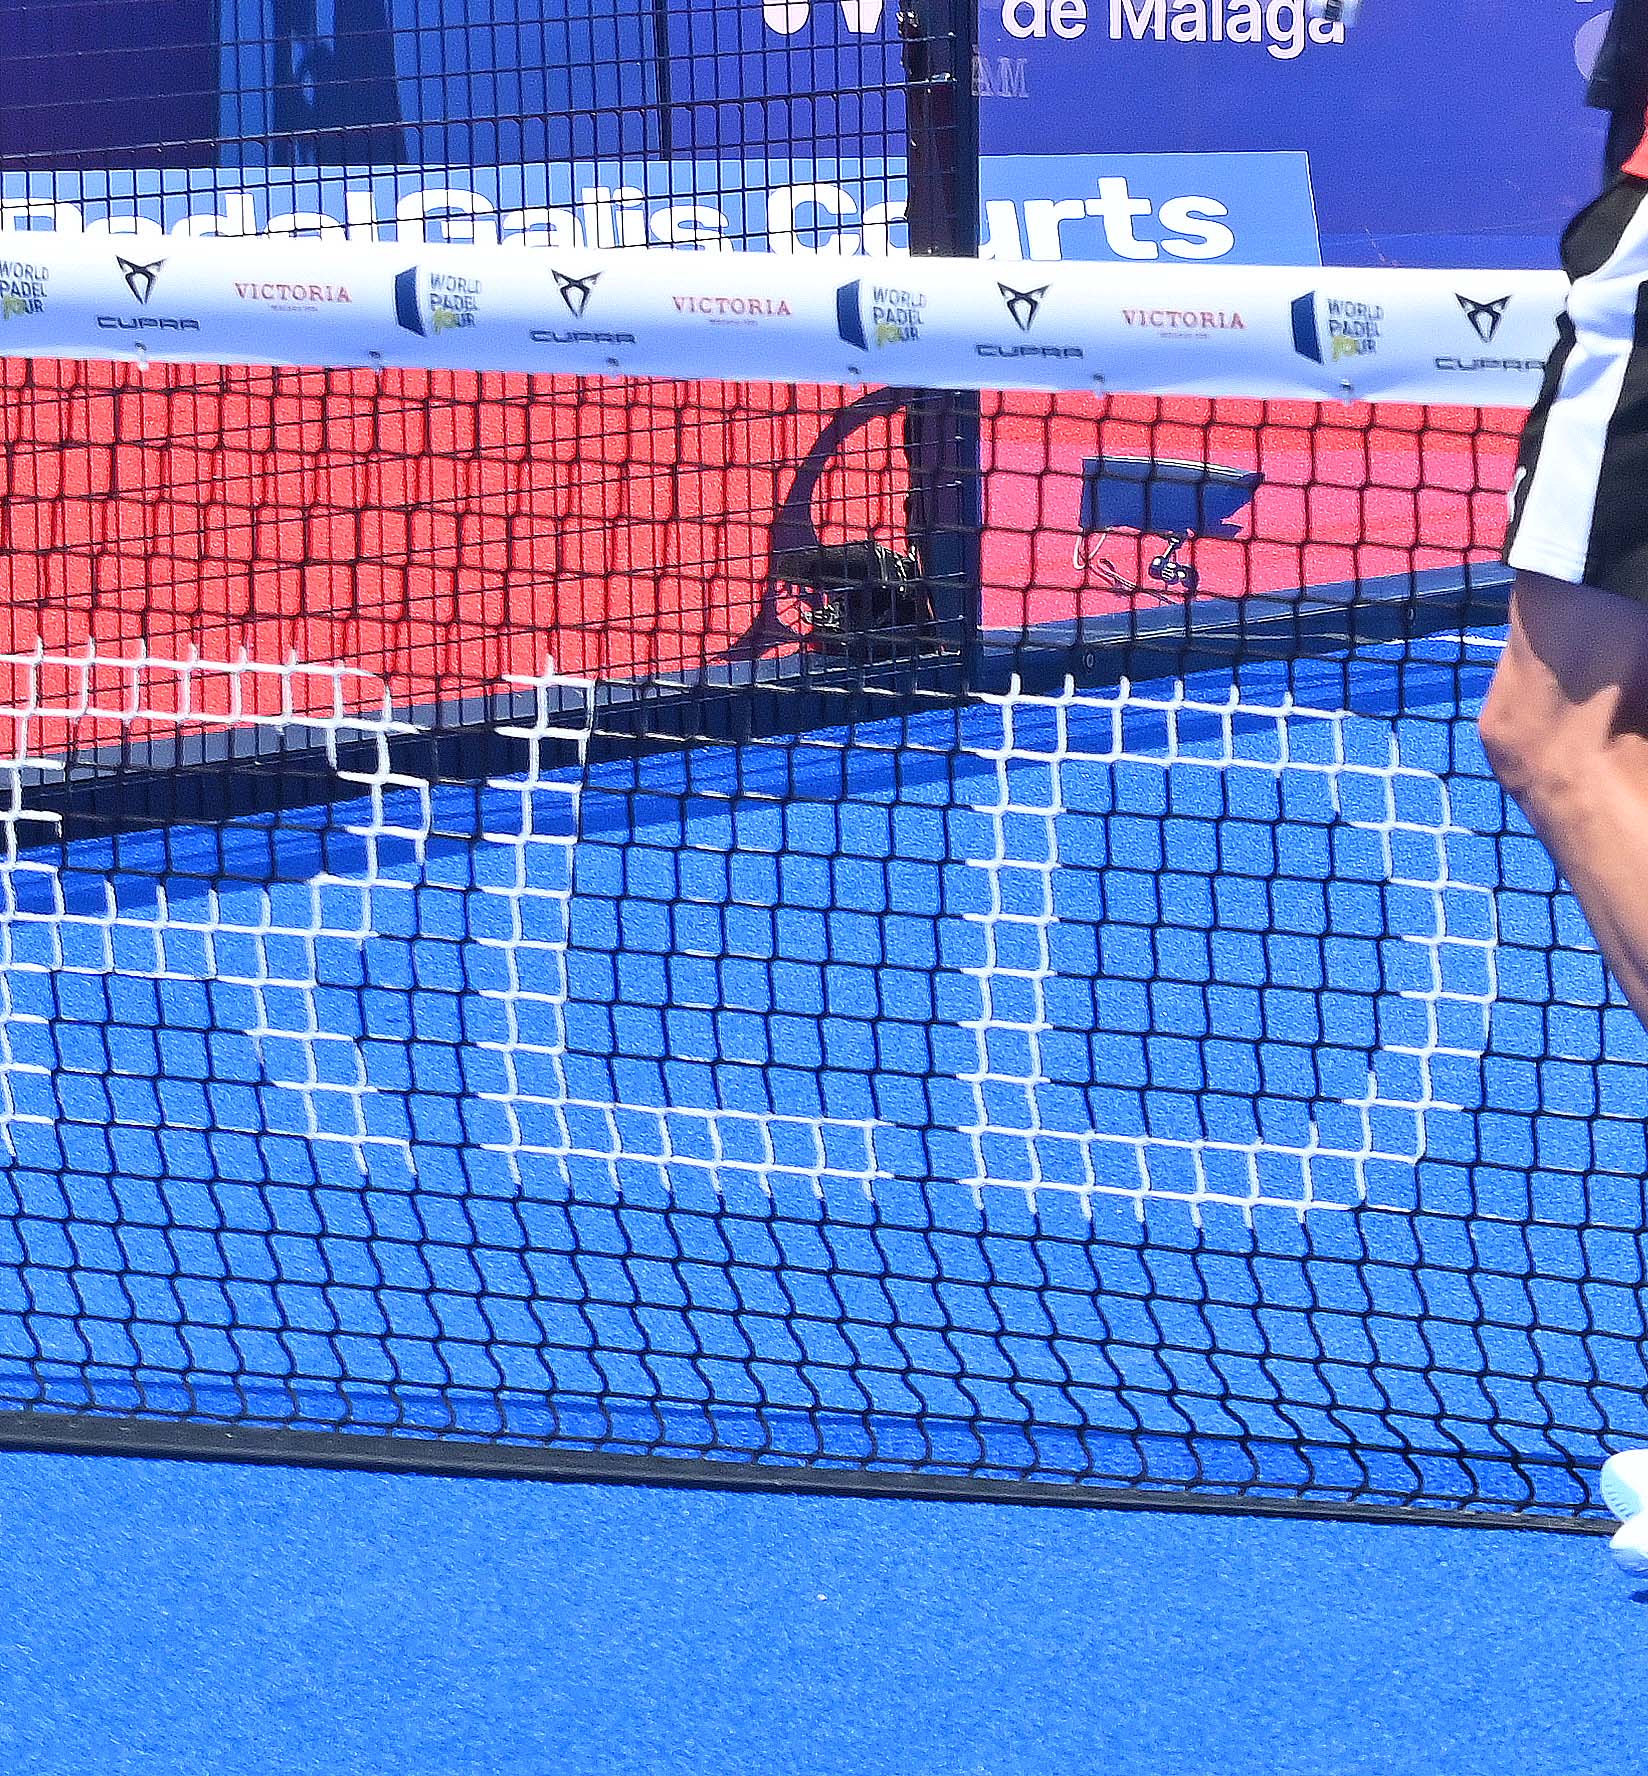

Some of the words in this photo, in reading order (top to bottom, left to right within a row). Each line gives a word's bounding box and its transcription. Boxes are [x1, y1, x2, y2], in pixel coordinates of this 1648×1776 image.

[235, 282, 352, 303] VICTORIA
[672, 296, 793, 316] VICTORIA
[97, 315, 200, 331] CUPRA
[1121, 309, 1247, 330] VICTORIA
[530, 329, 637, 344] CUPRA
[976, 344, 1083, 359] CUPRA
[1434, 356, 1546, 373] CUPRA
